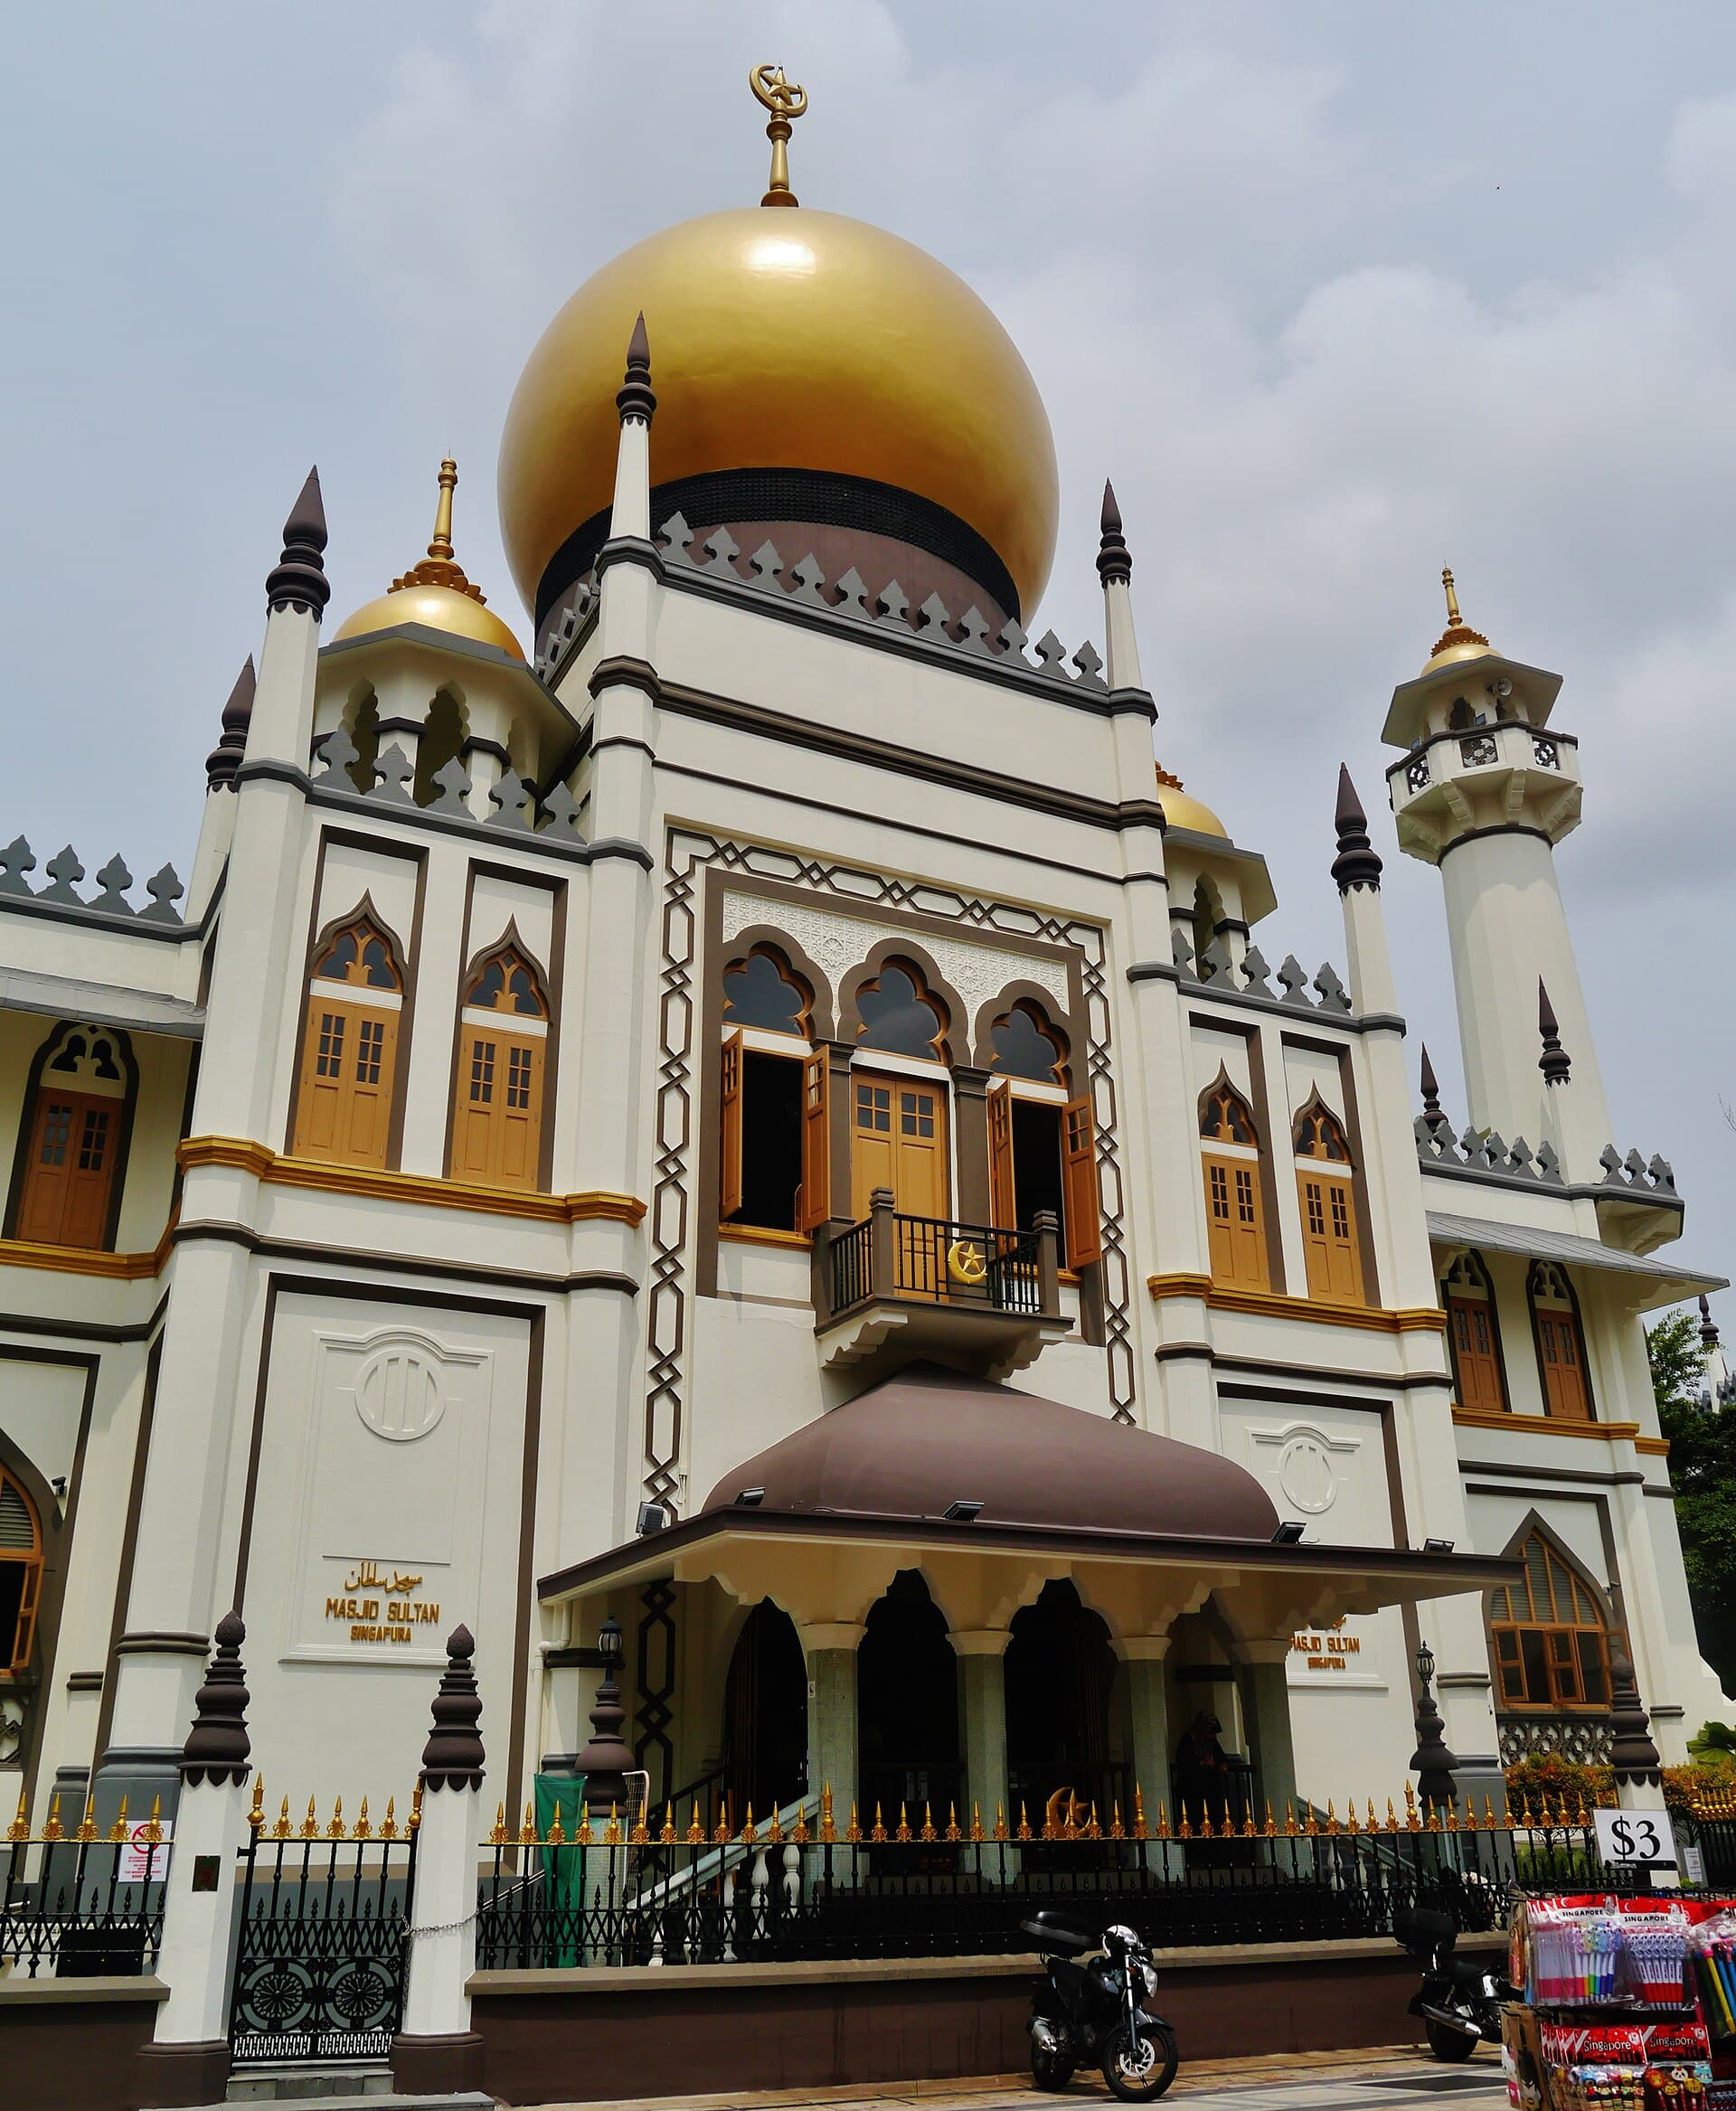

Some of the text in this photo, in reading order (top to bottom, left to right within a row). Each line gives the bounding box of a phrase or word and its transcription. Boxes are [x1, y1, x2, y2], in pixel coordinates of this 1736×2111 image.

[325, 1597, 439, 1624] MASJID SULTAN
[350, 1625, 411, 1643] SINGAPURA
[1326, 1635, 1361, 1654] SULTAN
[1611, 1815, 1660, 1861] $3
[1561, 1908, 1603, 1918] SINGAPORE
[1583, 2040, 1631, 2052] Singapore
[1649, 2036, 1697, 2048] Singapore
